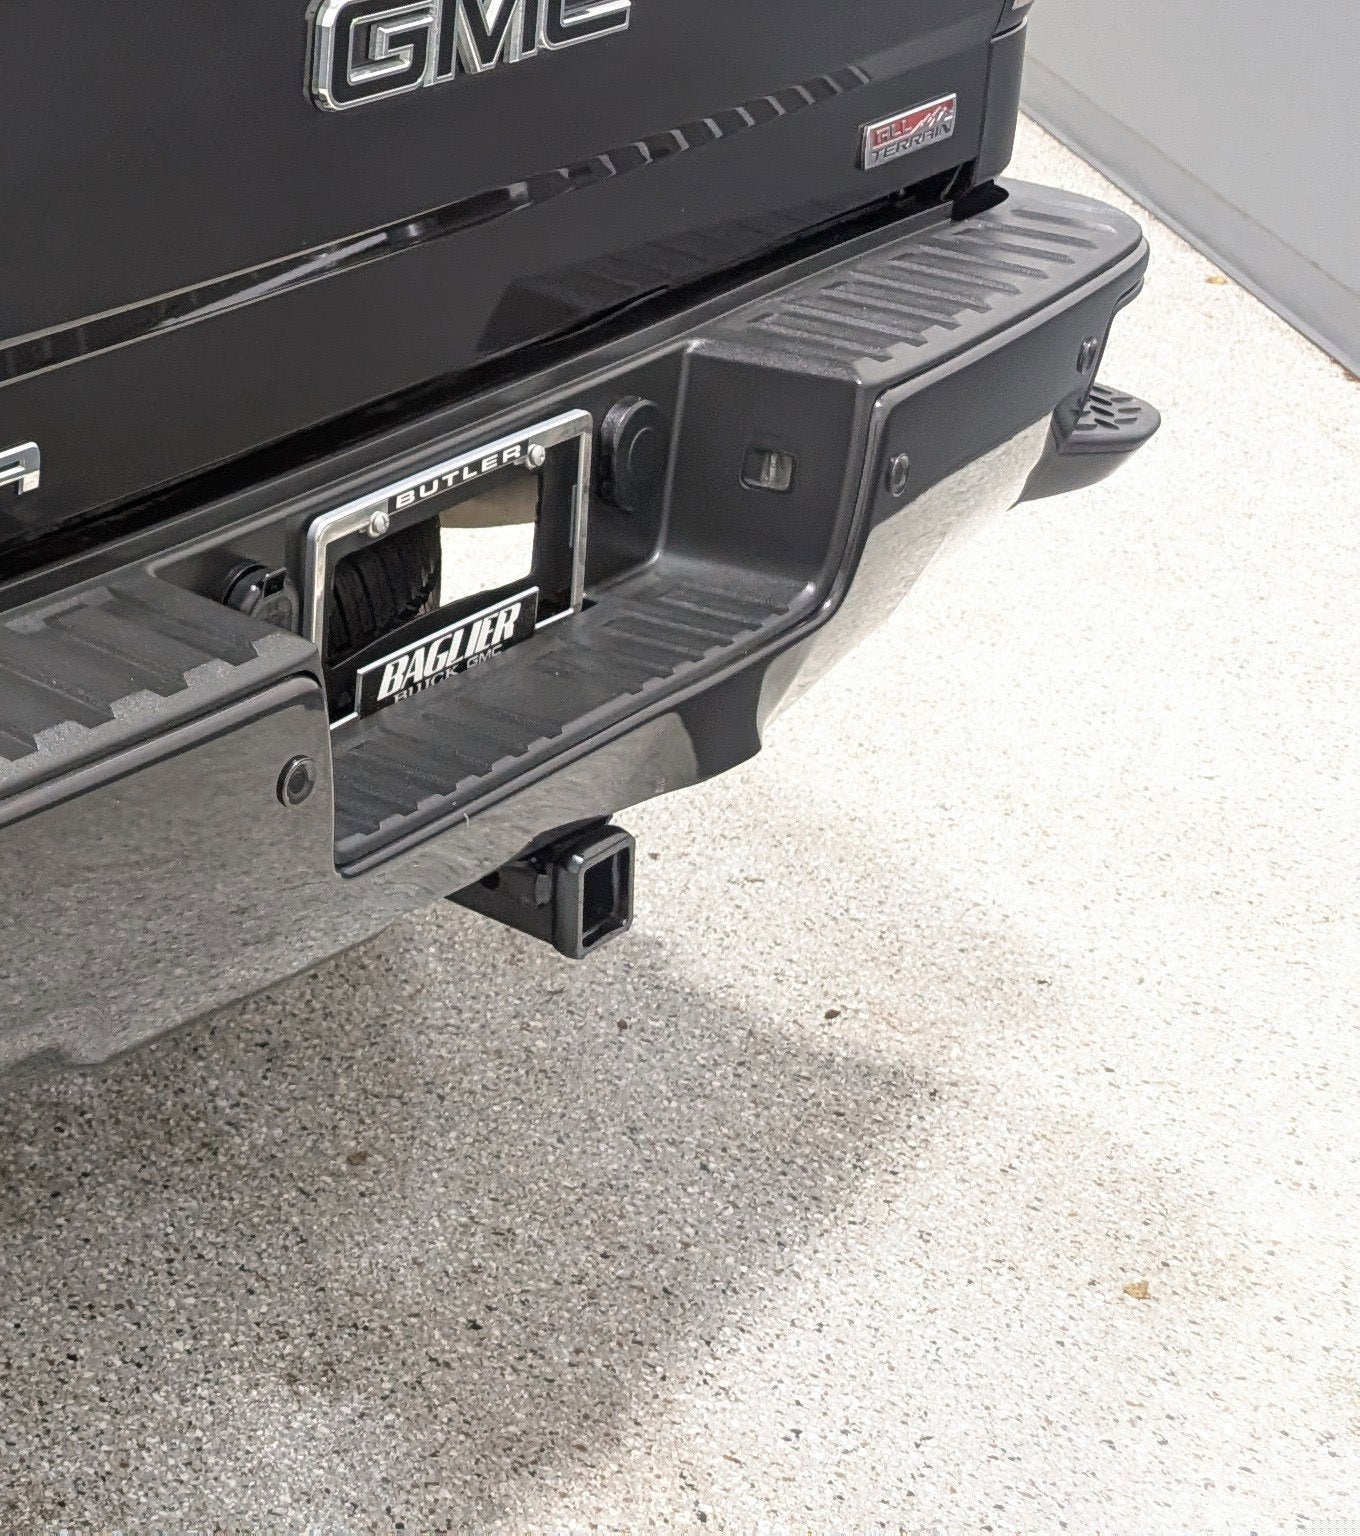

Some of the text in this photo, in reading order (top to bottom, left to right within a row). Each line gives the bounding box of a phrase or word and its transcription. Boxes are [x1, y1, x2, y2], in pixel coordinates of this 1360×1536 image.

[872, 120, 953, 162] TERRAIN
[395, 443, 523, 510] BUTLER
[376, 602, 522, 702] BAGLIER
[466, 643, 503, 670] GMC
